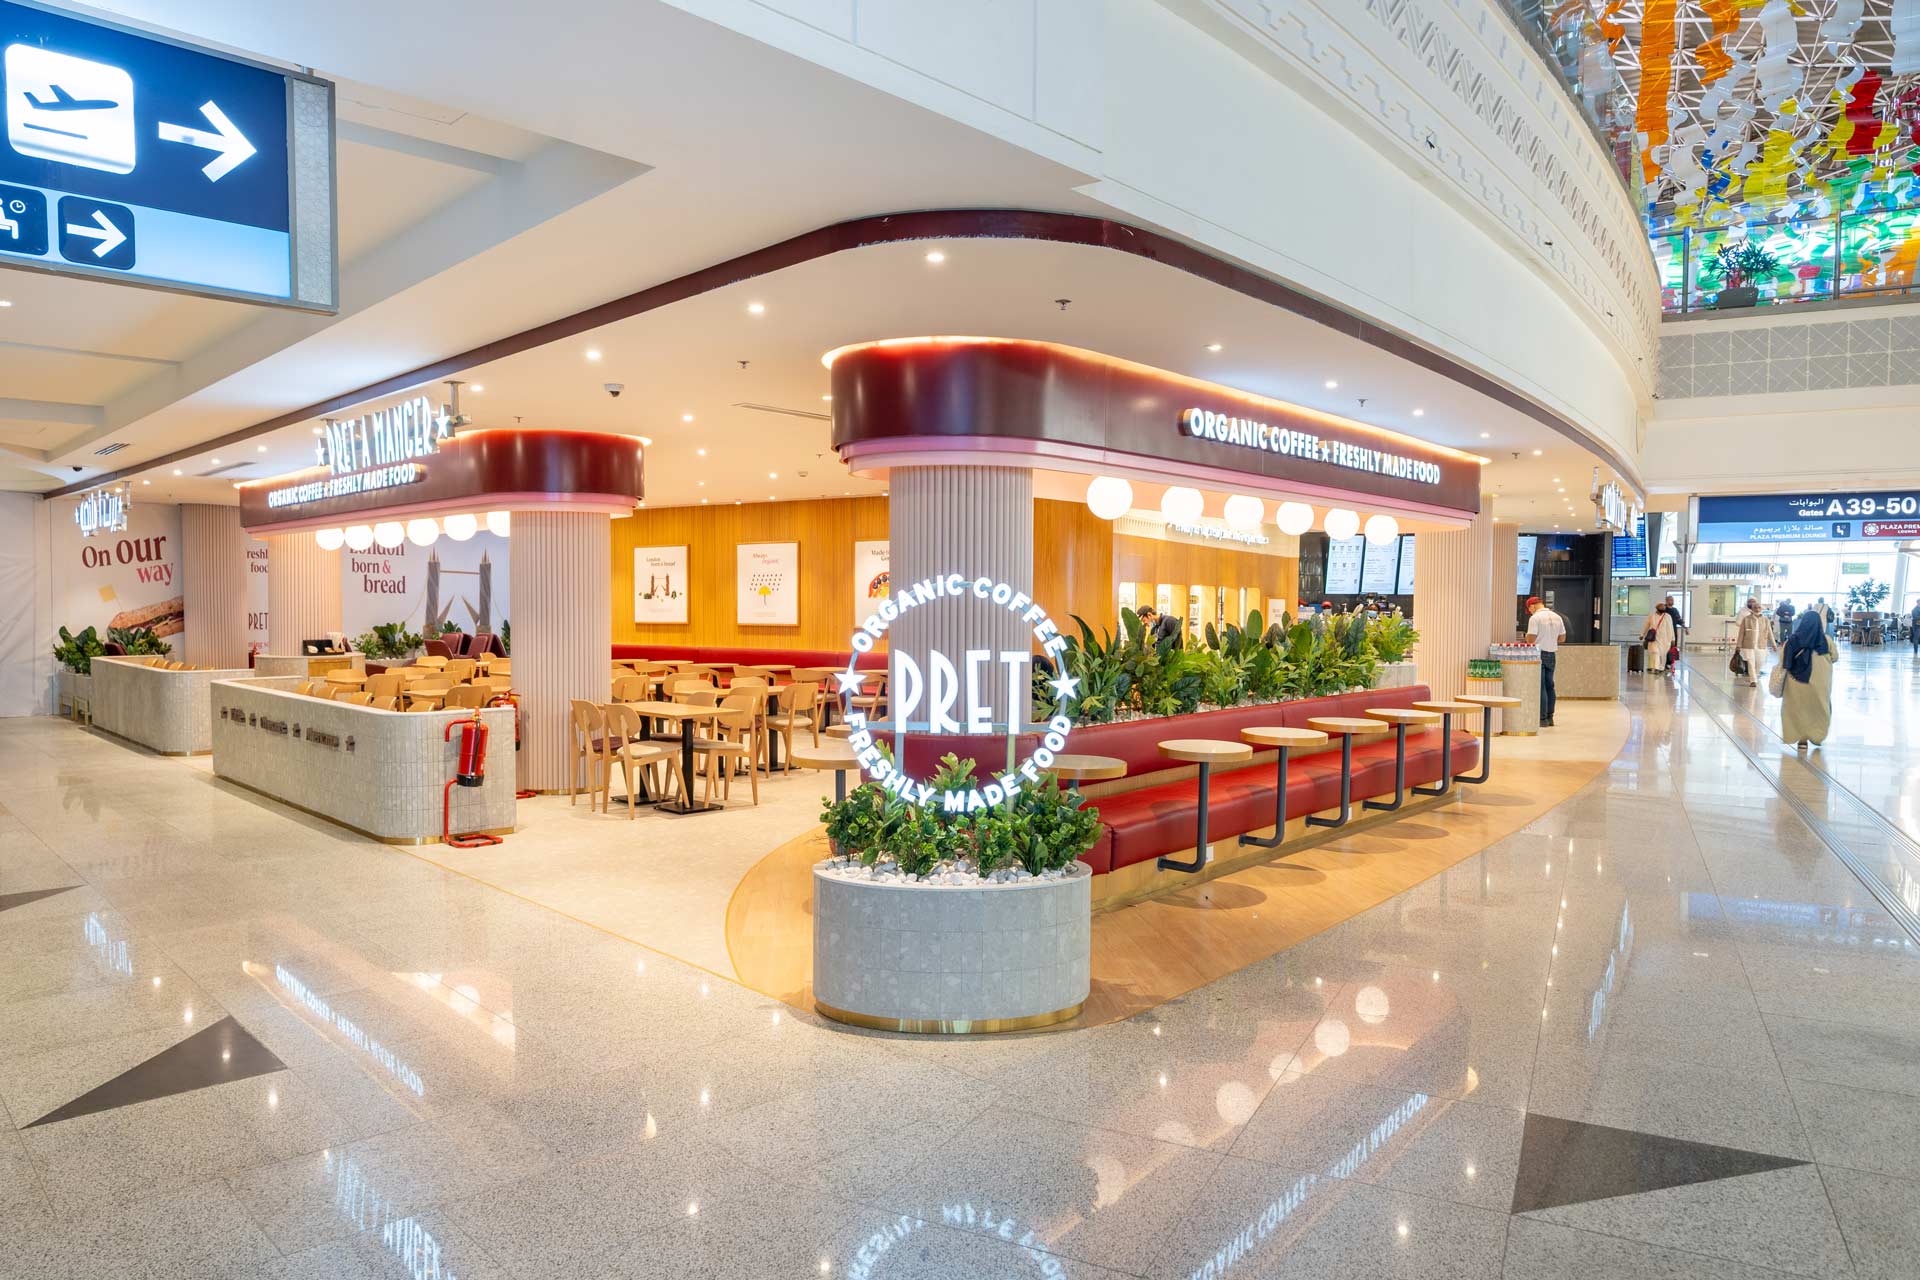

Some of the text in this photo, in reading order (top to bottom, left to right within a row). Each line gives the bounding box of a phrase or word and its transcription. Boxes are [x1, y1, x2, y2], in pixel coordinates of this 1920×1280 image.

[325, 396, 433, 476] PRET A MANGER
[1190, 407, 1440, 485] ORGANIC COFFEE FRESHLY MADE FOOD
[268, 462, 416, 508] ORGANIC COFFEE FRESHLY MADE FOOD
[1789, 498, 1824, 507] البوابات
[1798, 509, 1824, 517] Gates
[82, 536, 166, 568] On our
[351, 557, 391, 574] born &
[136, 562, 174, 586] way
[363, 574, 406, 594] bread
[248, 612, 269, 630] PRET
[851, 573, 1068, 658] ORGANIC COFFEE
[894, 649, 1030, 735] PRET
[843, 712, 1072, 812] FRESHLY MADE FOOD
